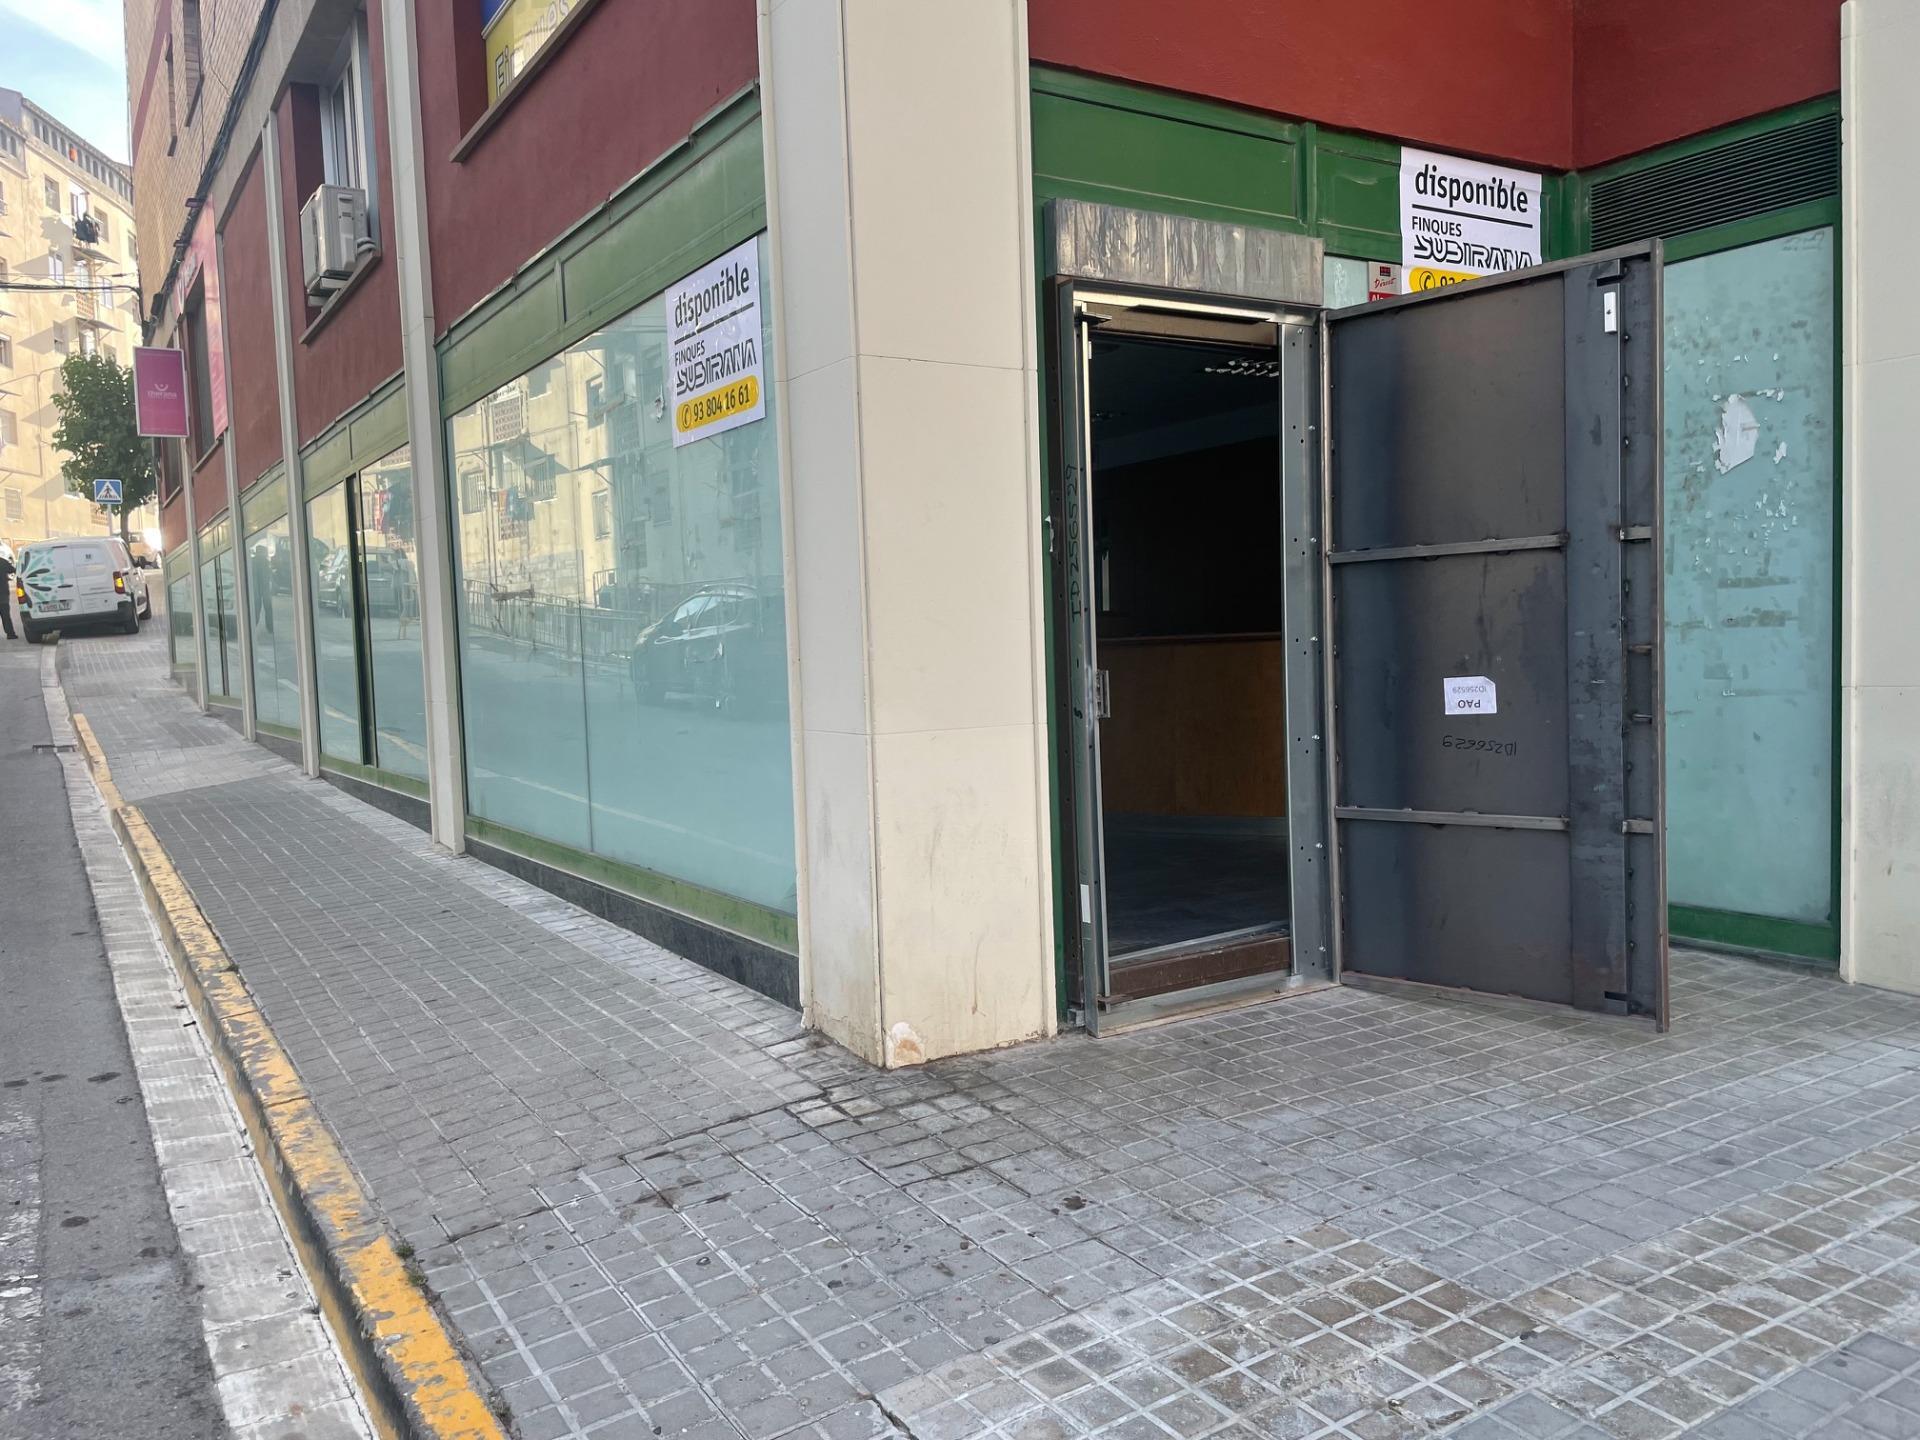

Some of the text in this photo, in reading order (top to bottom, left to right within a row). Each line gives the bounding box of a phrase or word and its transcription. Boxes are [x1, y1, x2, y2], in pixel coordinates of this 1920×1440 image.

[1415, 164, 1528, 213] disponible
[1412, 215, 1462, 237] FINQUES
[1414, 234, 1533, 271] SUBIRANA
[674, 262, 750, 329] disponible
[674, 340, 706, 367] FINQUES
[676, 337, 758, 396] SUBIRANA
[693, 383, 750, 422] 93 804 16 61
[1457, 699, 1481, 709] PAO
